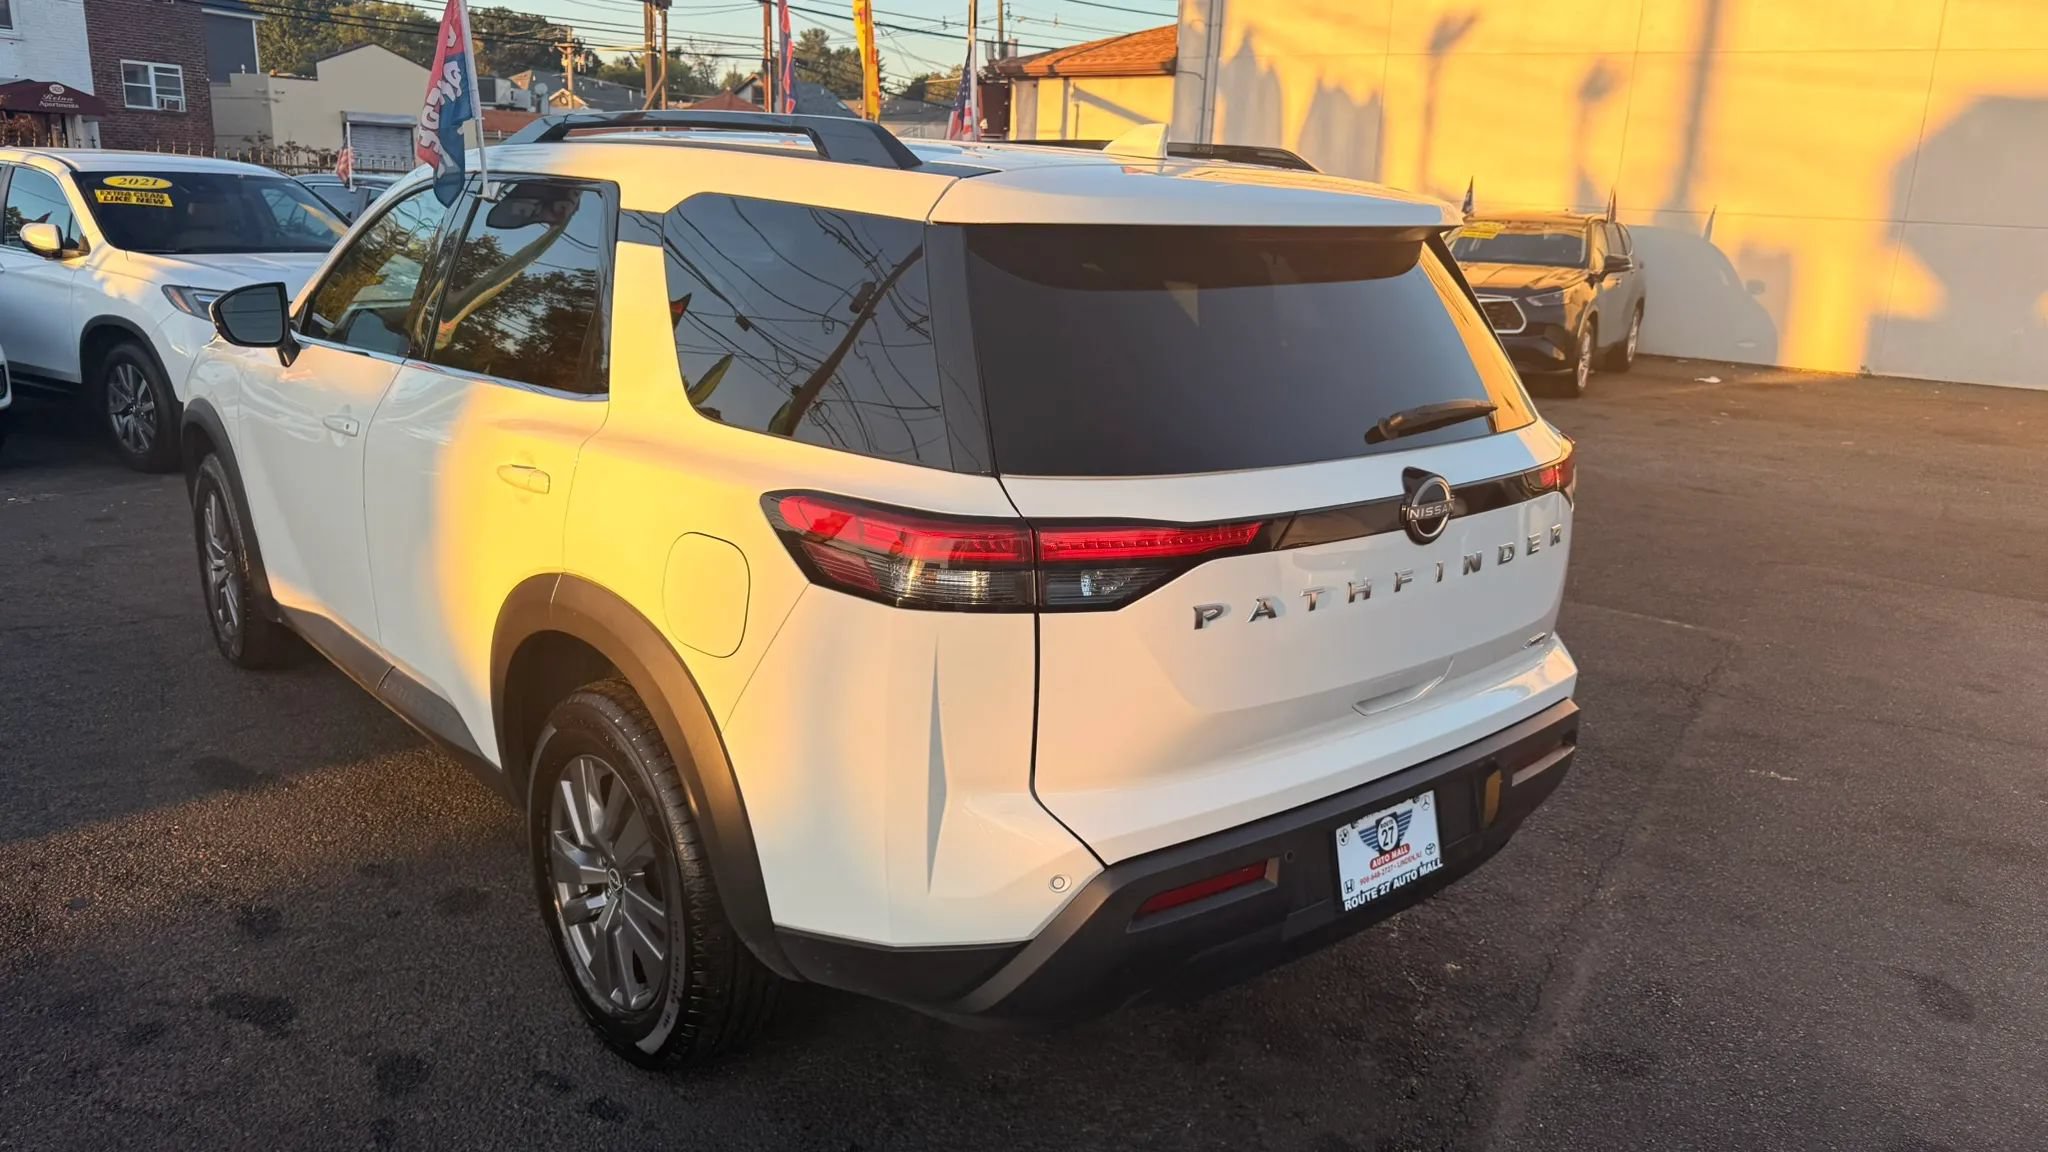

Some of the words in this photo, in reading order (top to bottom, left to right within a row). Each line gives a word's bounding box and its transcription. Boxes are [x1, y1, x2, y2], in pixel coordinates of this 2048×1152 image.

[39, 101, 80, 109] Apartments
[117, 177, 158, 186] 2021
[133, 191, 165, 199] CLEAN
[136, 197, 166, 205] NEW
[1410, 502, 1454, 519] NISSAN
[1193, 524, 1562, 630] PATHFINDER
[1380, 819, 1394, 829] ROUTE
[1381, 826, 1394, 848] 27
[1372, 854, 1390, 868] AUTO
[1391, 845, 1408, 861] MALL
[1344, 888, 1378, 911] ROUTE
[1380, 882, 1390, 896] 27
[1393, 871, 1418, 890] AUTO
[1420, 858, 1444, 876] MALL
